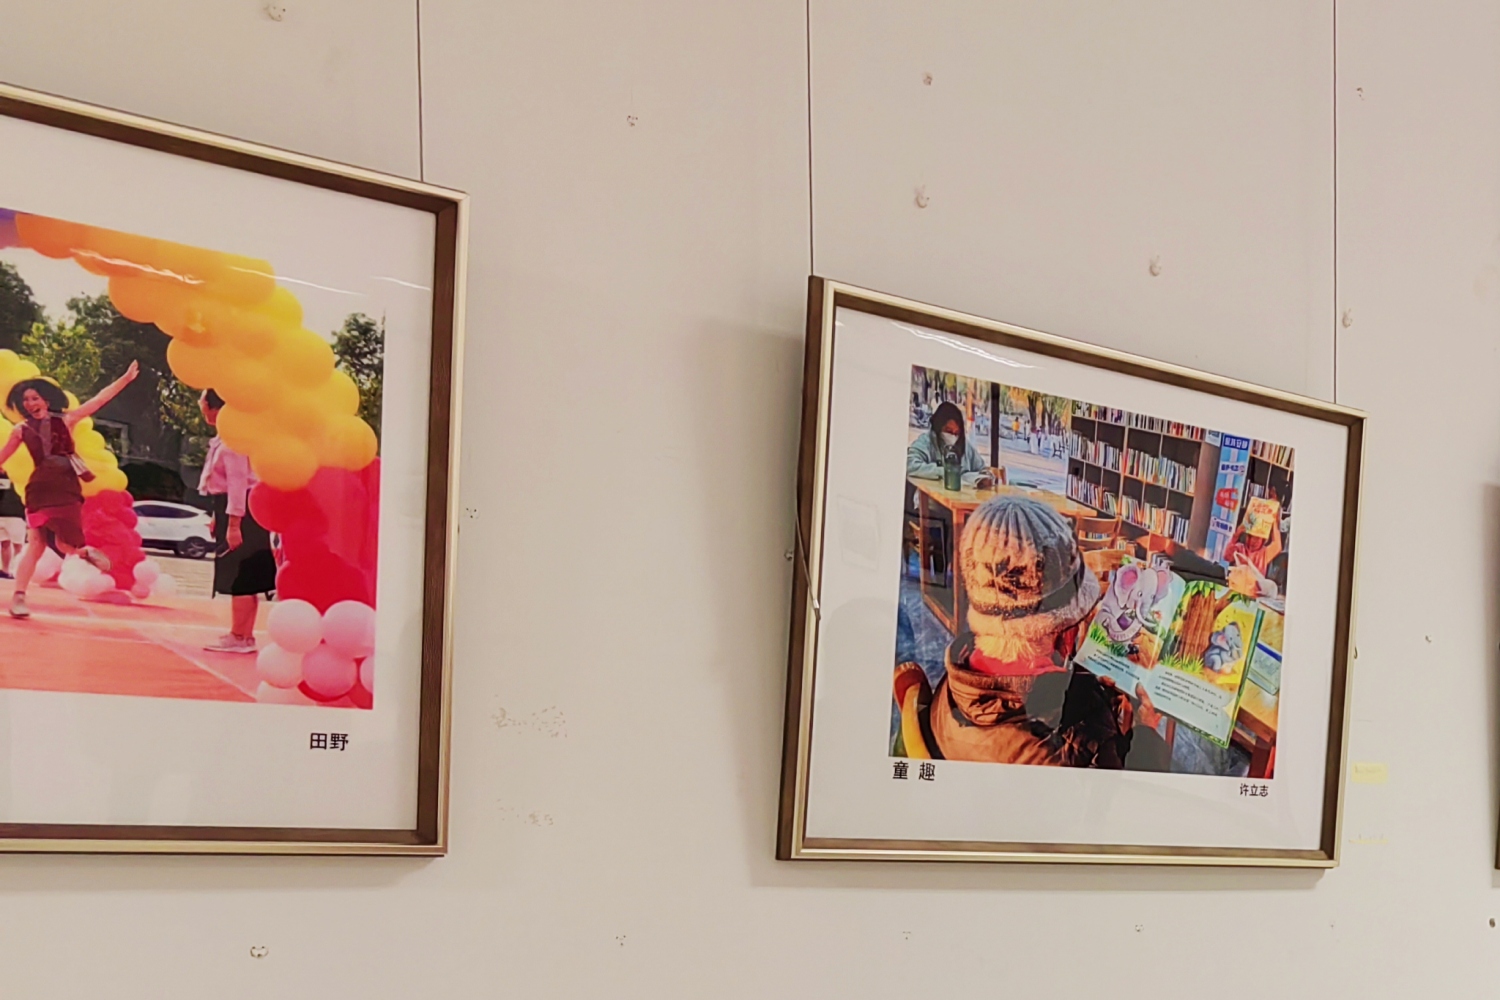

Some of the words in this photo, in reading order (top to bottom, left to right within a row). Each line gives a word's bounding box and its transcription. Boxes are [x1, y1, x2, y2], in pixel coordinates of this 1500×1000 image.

[309, 732, 349, 751] 田野
[892, 760, 936, 781] 童趣
[1239, 783, 1269, 797] 许立志
